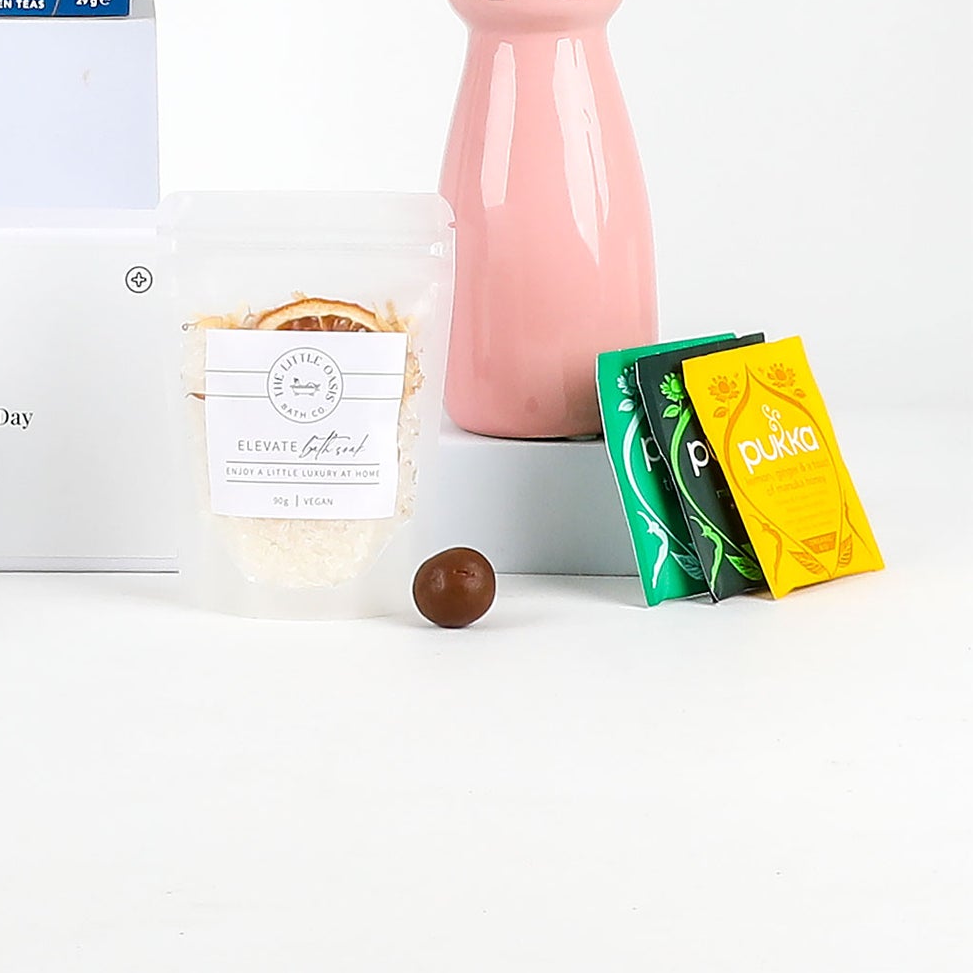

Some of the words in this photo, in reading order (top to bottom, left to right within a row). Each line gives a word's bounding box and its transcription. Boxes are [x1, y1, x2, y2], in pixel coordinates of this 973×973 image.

[15, 0, 45, 10] TEAS
[273, 372, 285, 397] THE
[280, 353, 323, 371] LITTLE
[323, 364, 339, 403] OASIS
[280, 403, 307, 418] BATH
[237, 439, 298, 453] ELEVATE
[738, 405, 819, 474] pukka
[225, 466, 254, 476] ENJOY
[257, 468, 264, 476] A
[266, 468, 298, 478] LITTLE
[301, 469, 338, 478] LUXURY
[340, 469, 351, 478] AT
[355, 469, 380, 478] HOME
[303, 497, 333, 506] VEGAN
